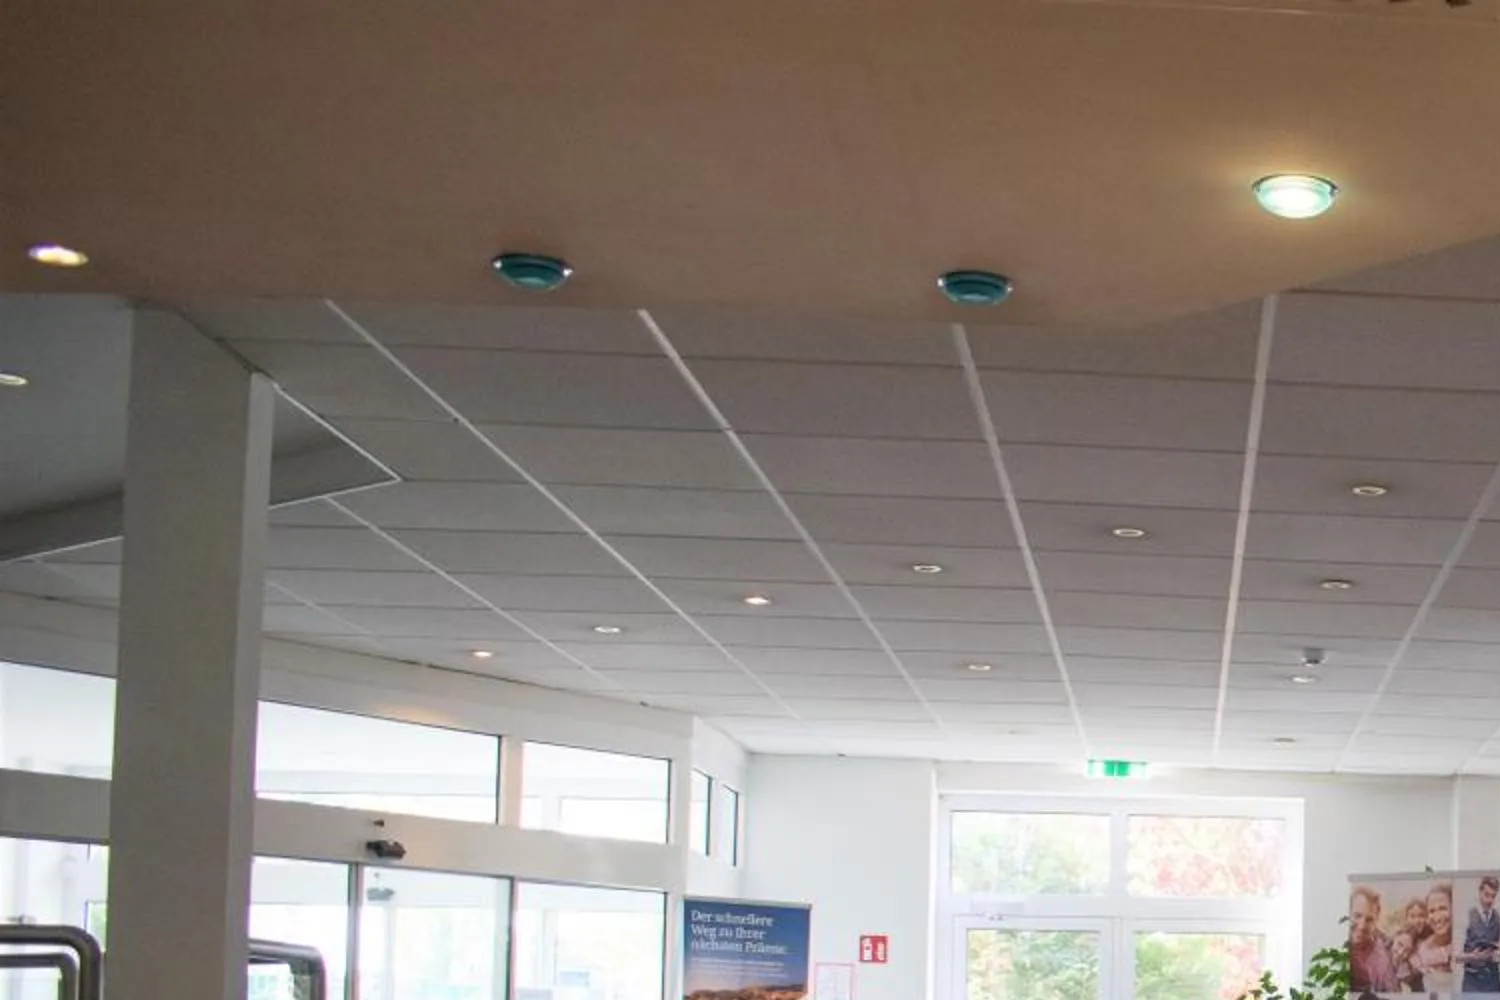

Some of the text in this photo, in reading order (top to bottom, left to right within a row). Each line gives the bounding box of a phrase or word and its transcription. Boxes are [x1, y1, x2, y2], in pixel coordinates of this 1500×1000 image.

[690, 909, 774, 928] Der schnellere
[691, 924, 766, 941] Weg zu Ihrer
